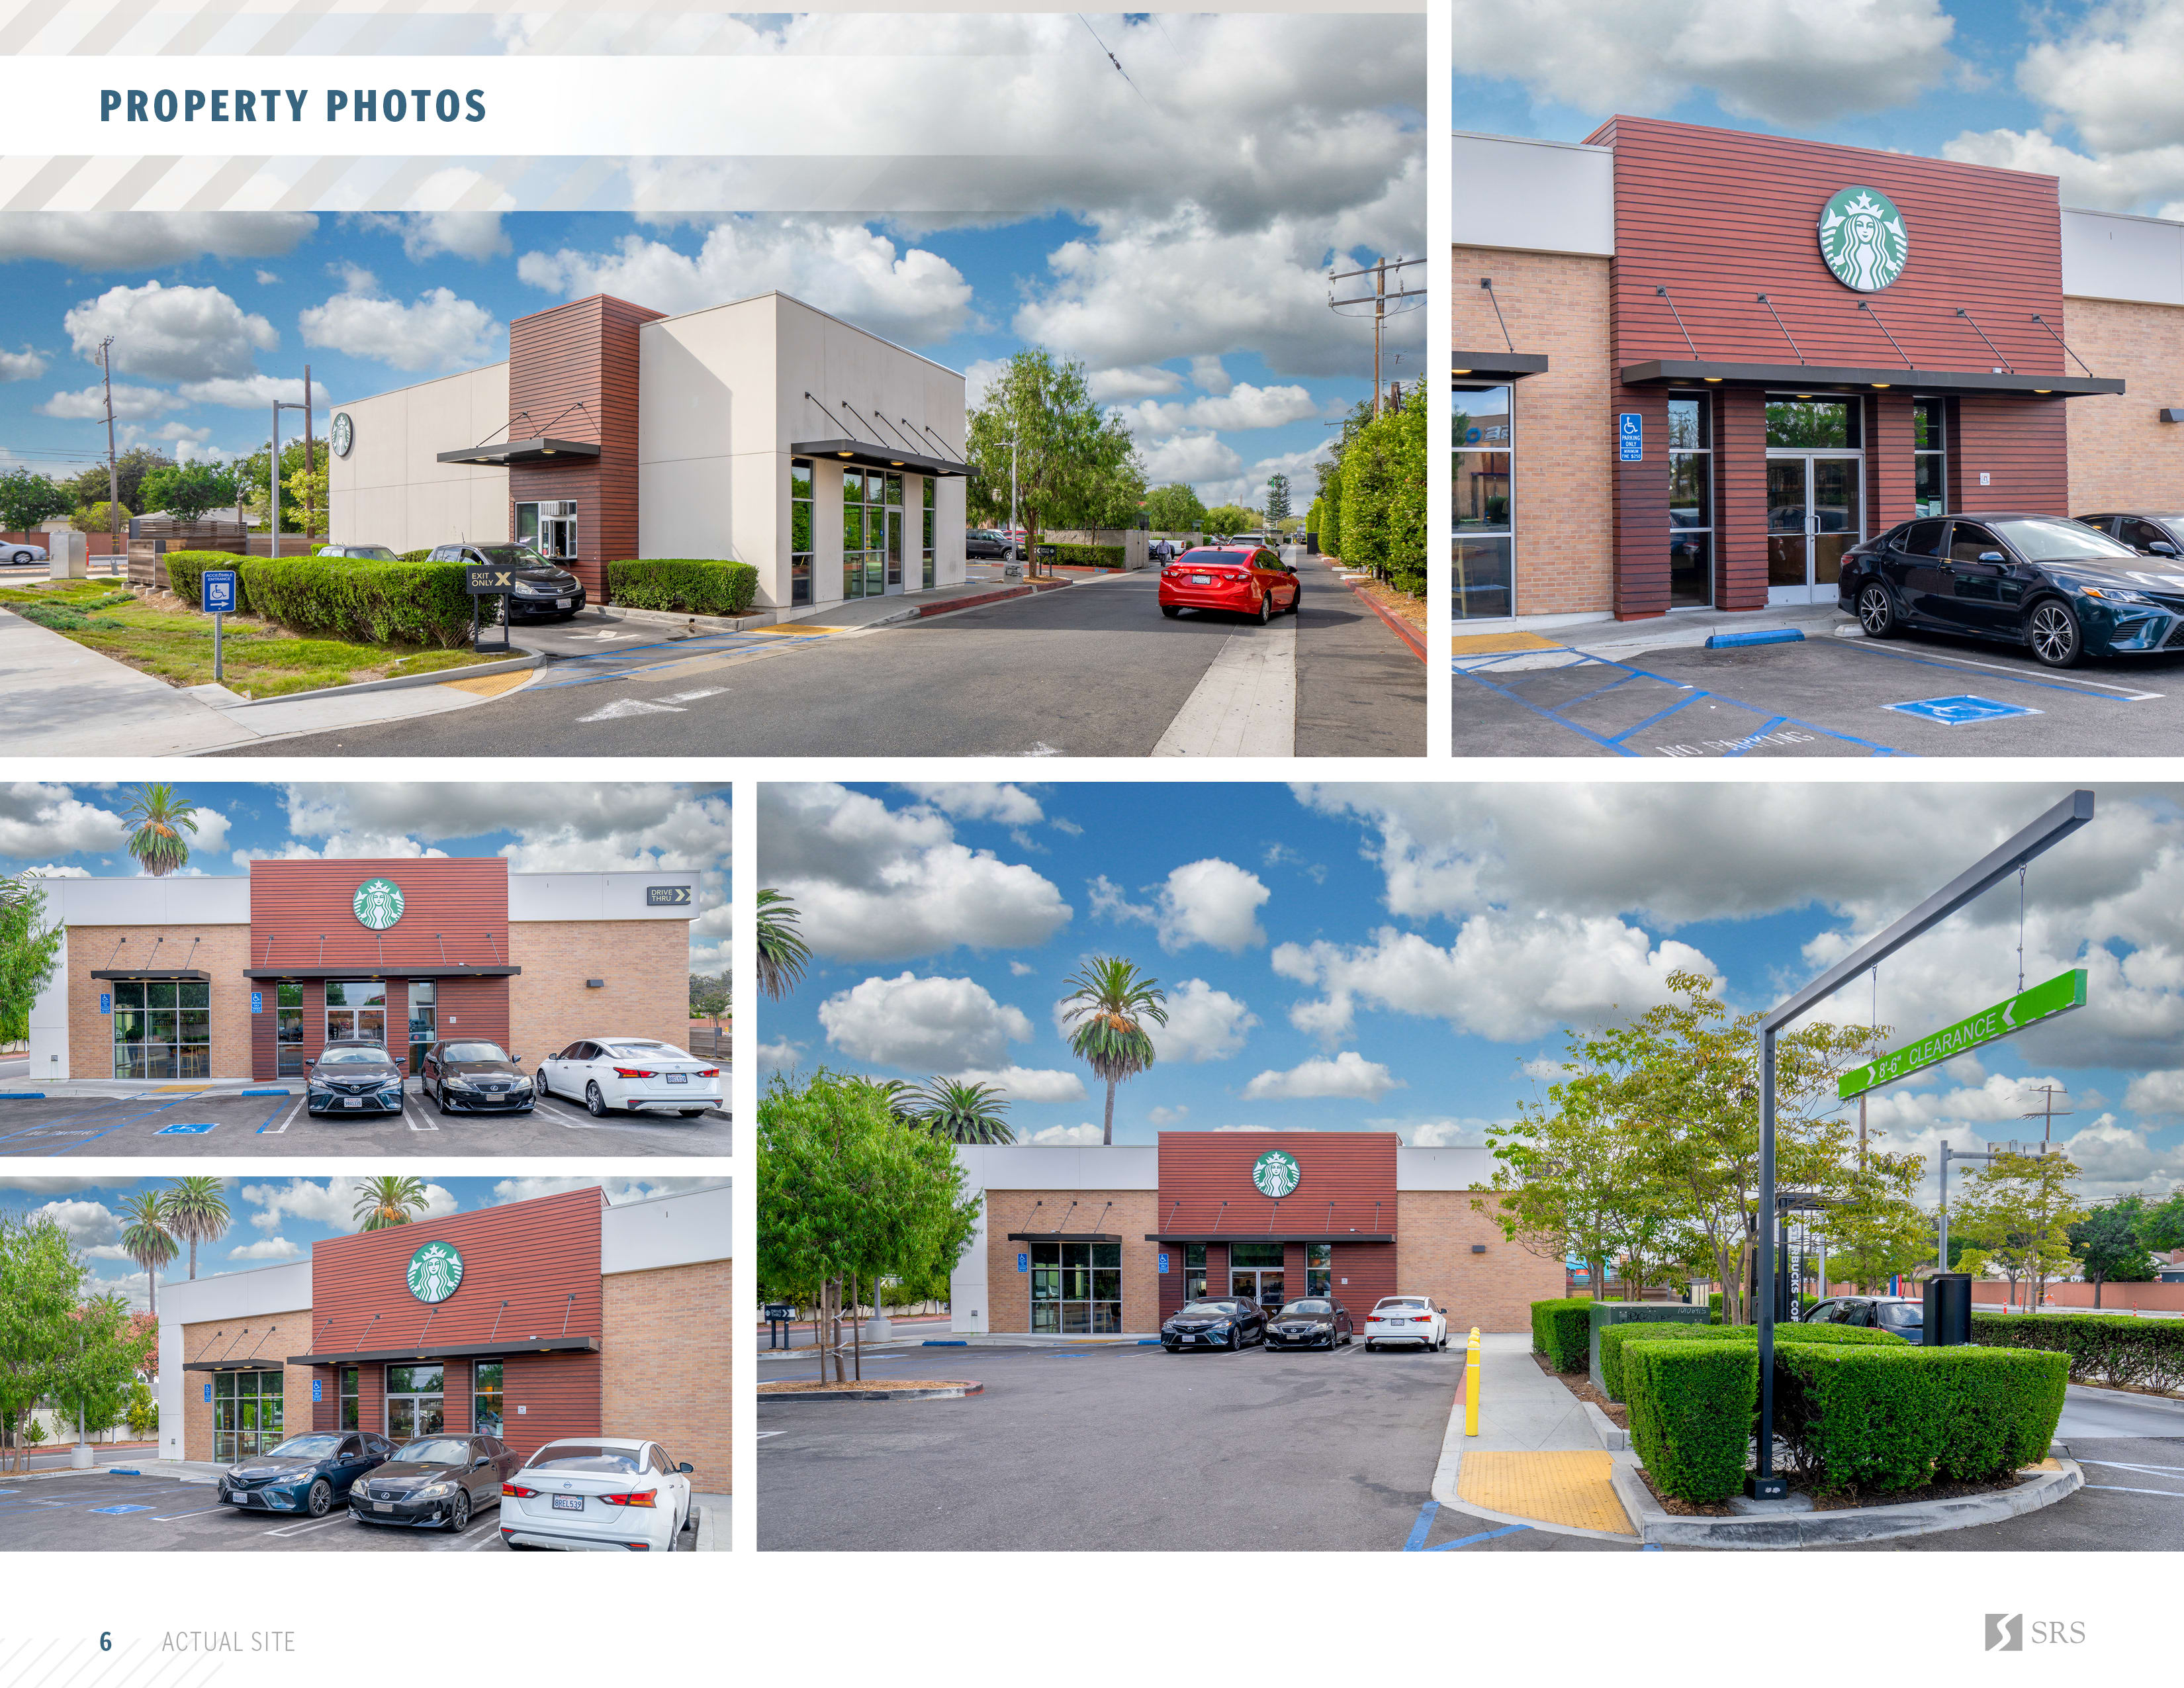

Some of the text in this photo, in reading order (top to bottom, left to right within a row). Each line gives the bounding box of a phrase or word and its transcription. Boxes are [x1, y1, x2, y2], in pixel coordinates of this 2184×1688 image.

[1655, 744, 1704, 757] NO
[1909, 1012, 1996, 1065] CLEARANCE
[555, 1499, 582, 1509] 8REL539
